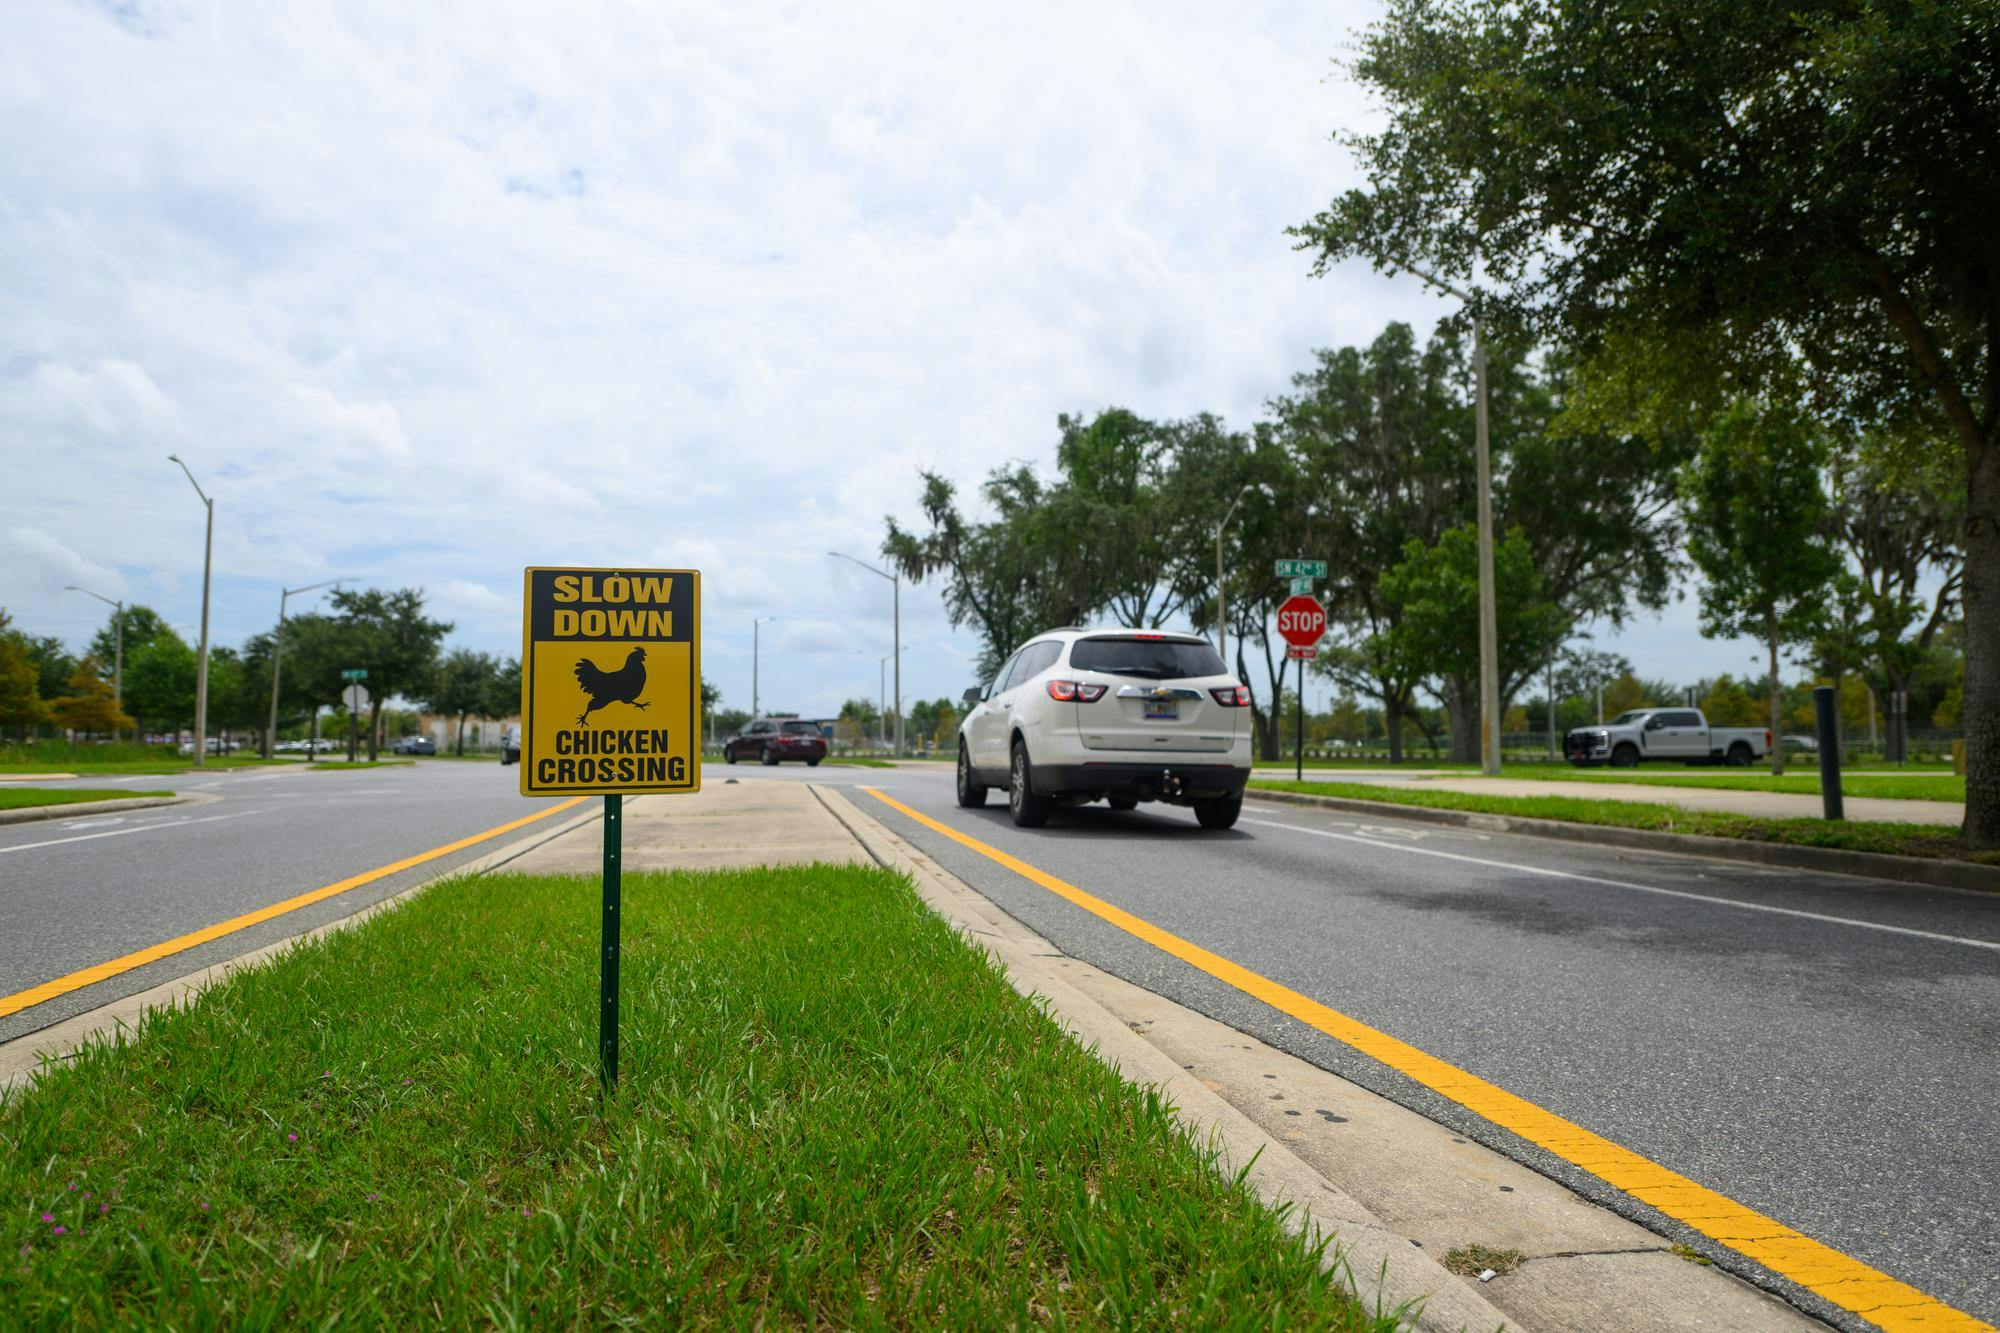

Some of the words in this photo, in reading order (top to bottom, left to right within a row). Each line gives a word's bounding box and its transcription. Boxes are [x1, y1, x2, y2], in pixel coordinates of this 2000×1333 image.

[1279, 561, 1291, 575] SW
[1316, 562, 1325, 575] ST
[553, 575, 673, 603] SLOW
[553, 609, 673, 637] DOWN
[1281, 611, 1323, 632] STOP
[555, 730, 669, 755] CHICKEN
[537, 756, 685, 784] CROSSING
